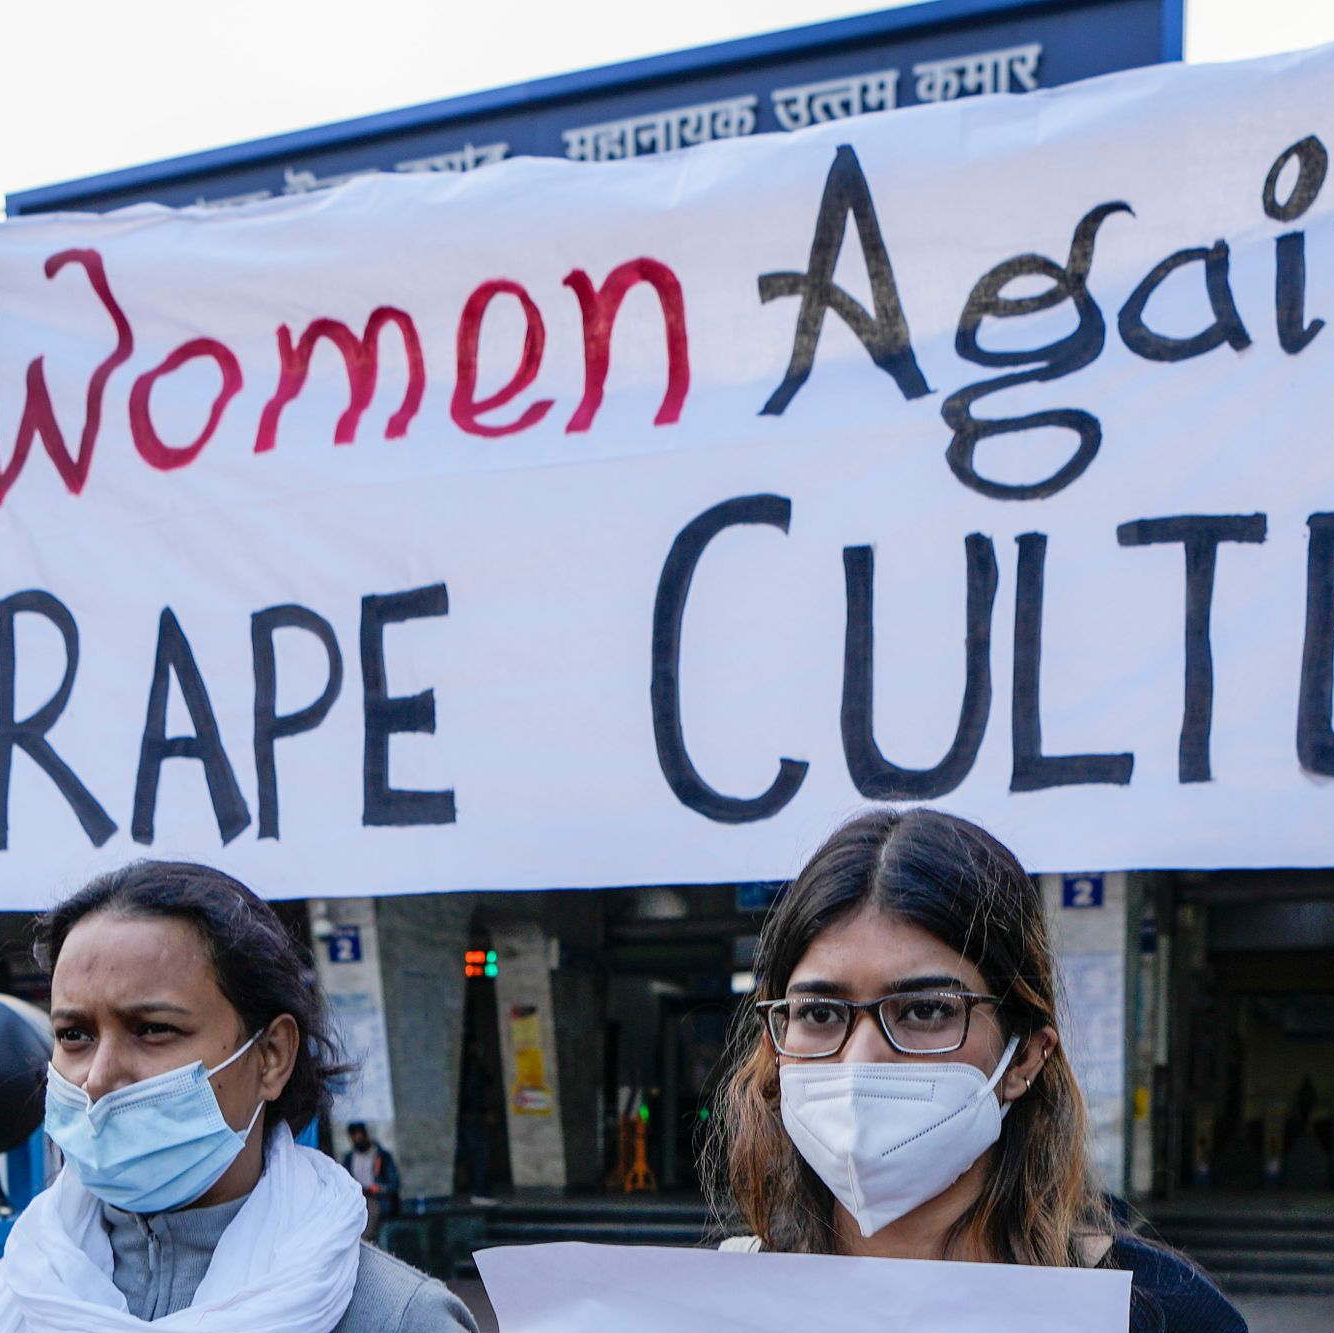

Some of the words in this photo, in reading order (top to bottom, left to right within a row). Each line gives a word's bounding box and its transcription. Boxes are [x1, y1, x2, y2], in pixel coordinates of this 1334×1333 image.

[770, 68, 898, 133] उत्तम
[913, 42, 1042, 102] कमार
[1073, 878, 1095, 906] 2
[335, 938, 355, 961] 2
